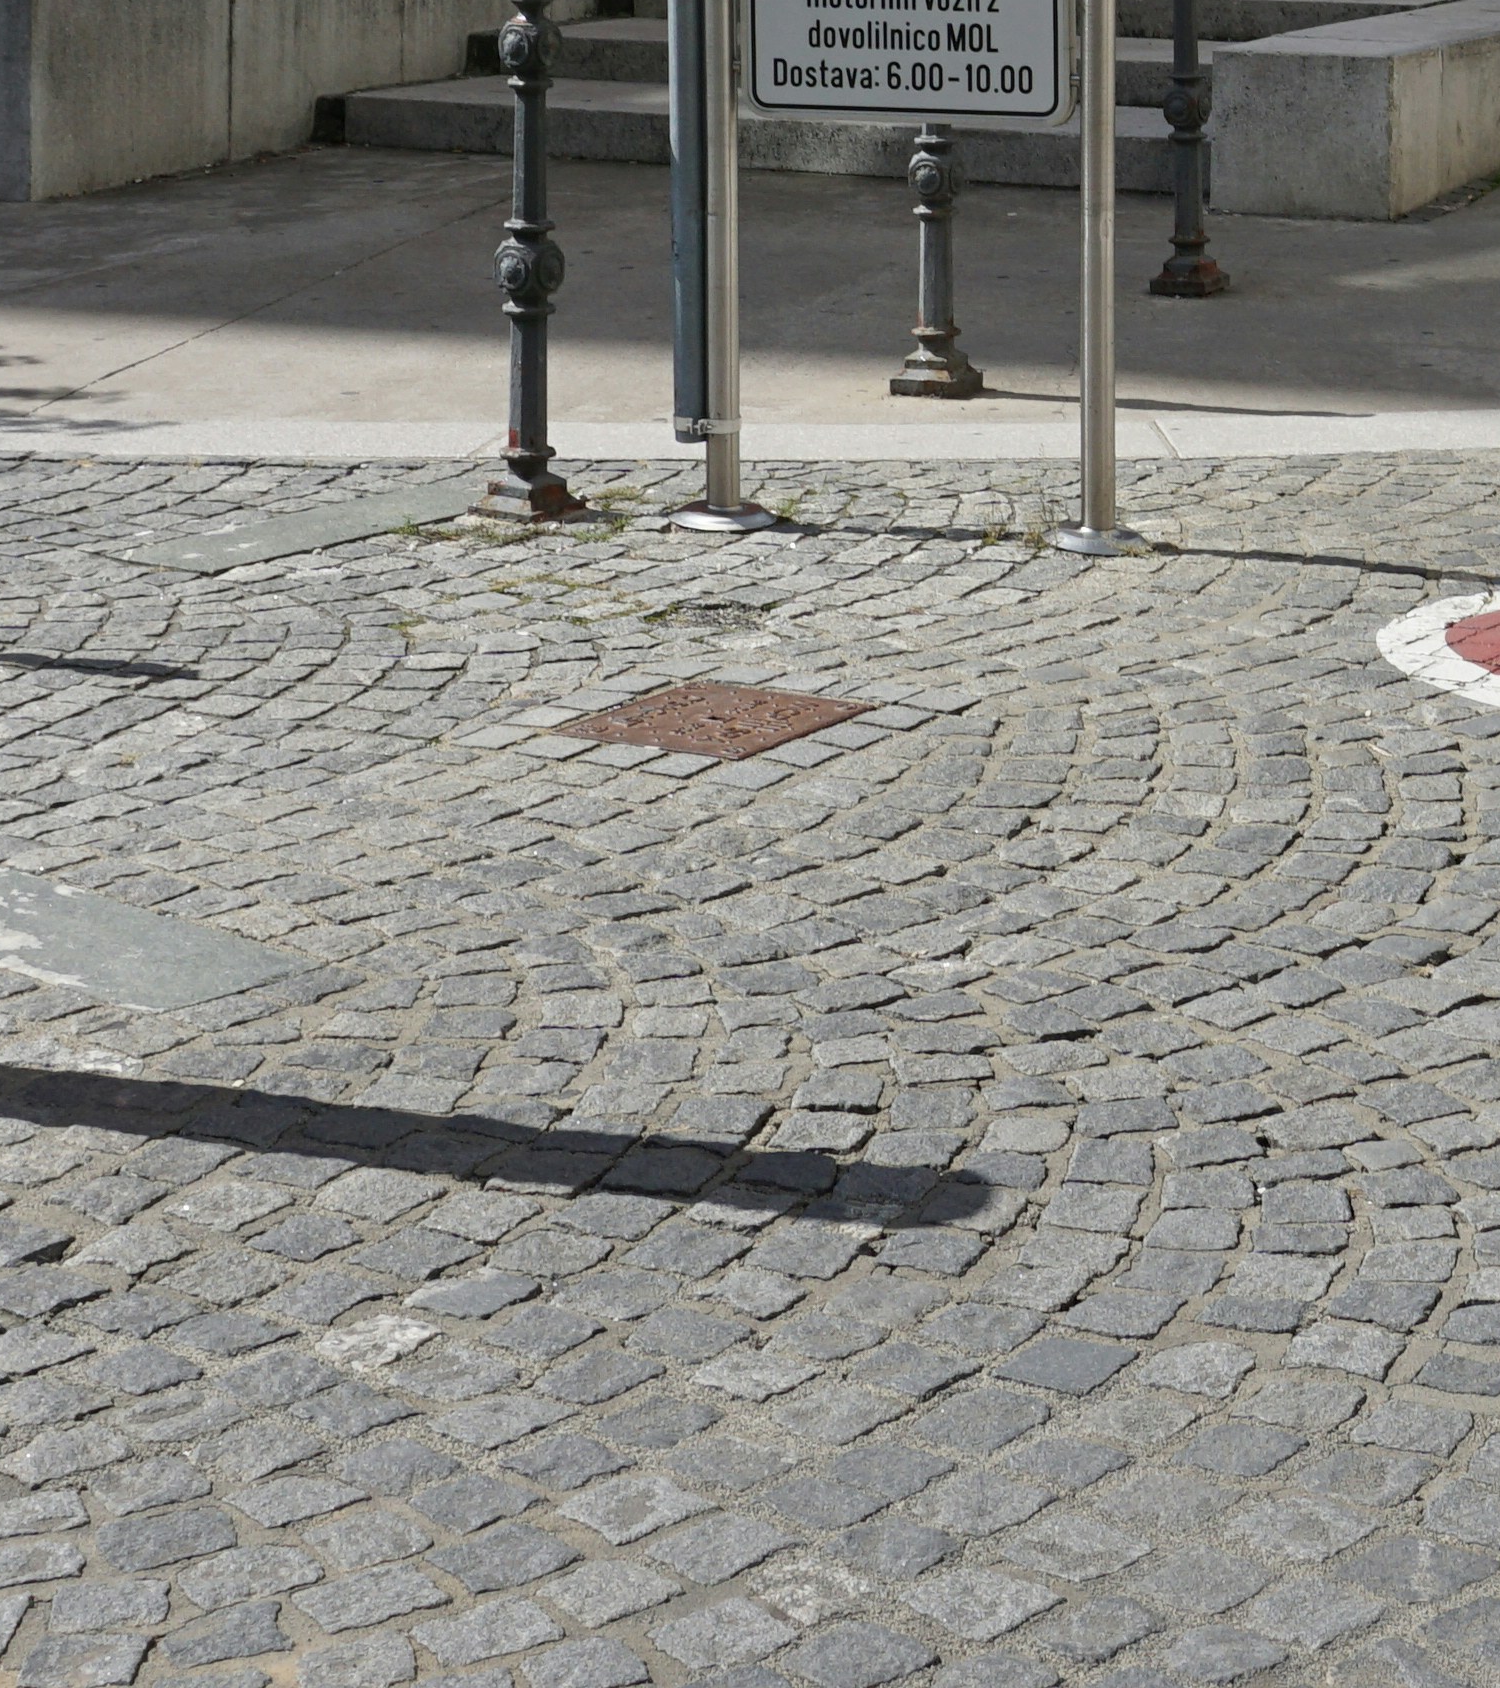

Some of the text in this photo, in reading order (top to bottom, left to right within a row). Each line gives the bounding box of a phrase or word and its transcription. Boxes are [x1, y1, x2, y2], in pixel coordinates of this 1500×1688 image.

[808, 21, 999, 53] dovolilnico MOL
[773, 58, 879, 89] Dostava:
